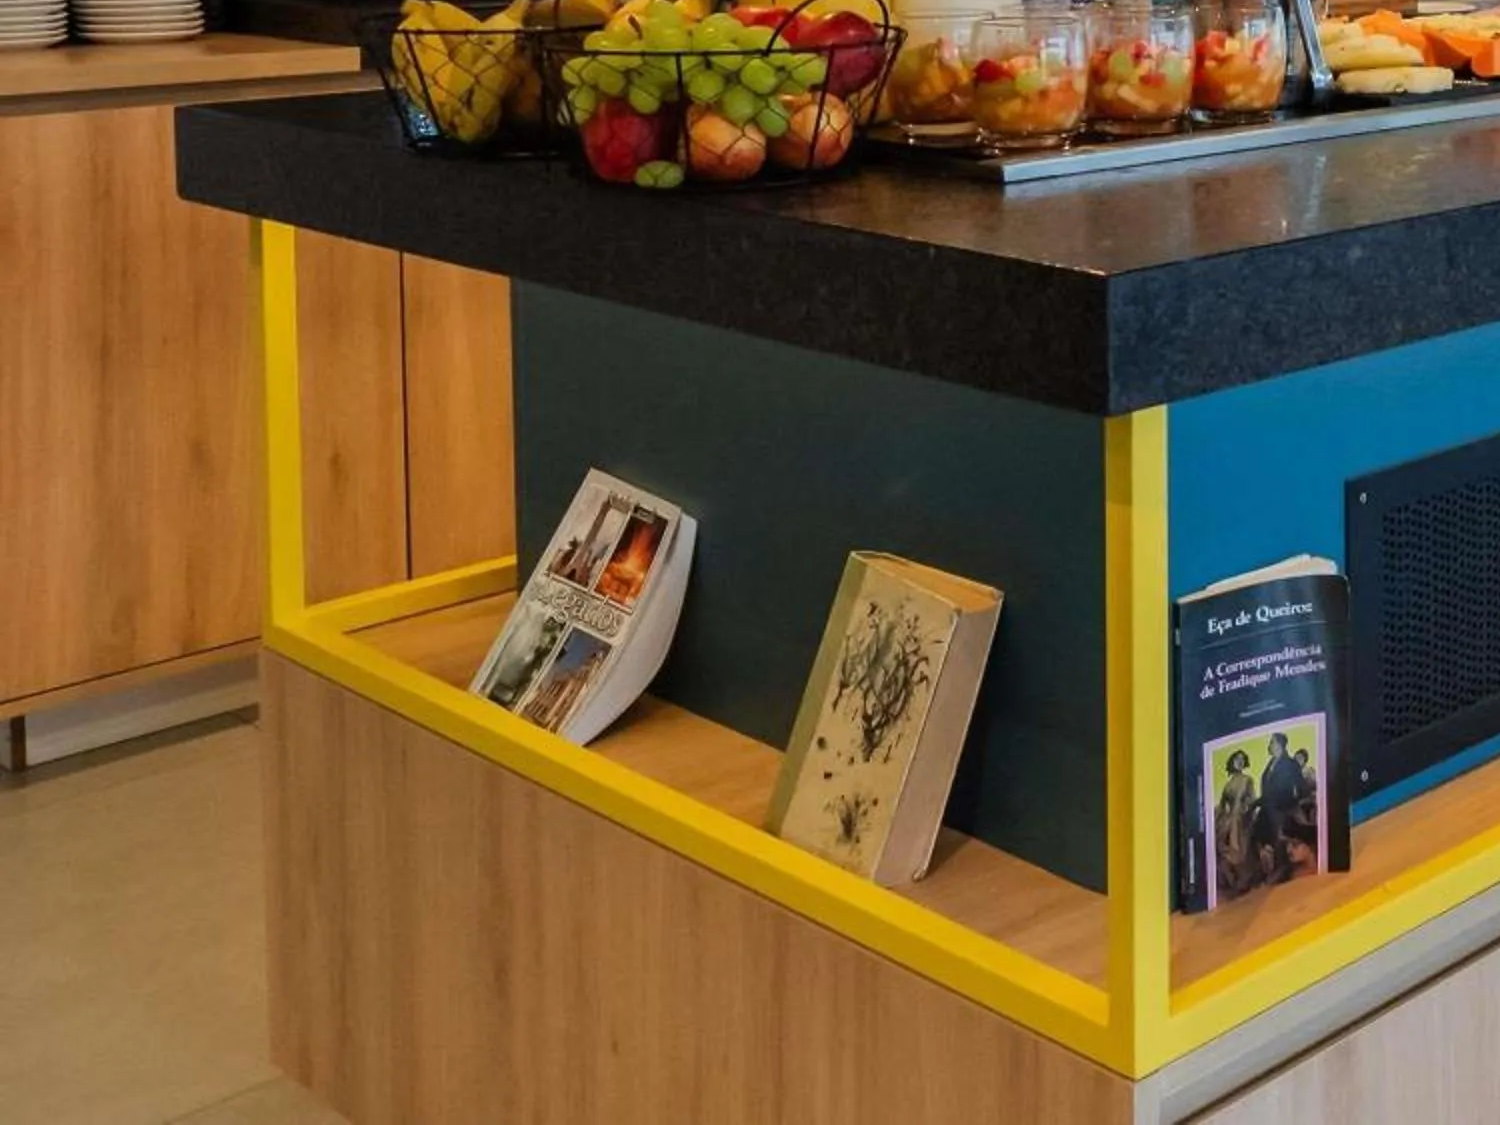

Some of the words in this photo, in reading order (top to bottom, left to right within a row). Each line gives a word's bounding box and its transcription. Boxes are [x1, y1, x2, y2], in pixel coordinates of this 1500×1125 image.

[1207, 617, 1233, 635] Eça
[1235, 611, 1252, 627] de
[1255, 601, 1313, 622] Queiroz
[1199, 686, 1216, 701] de
[1275, 660, 1327, 679] Mendes
[1203, 667, 1214, 681] A
